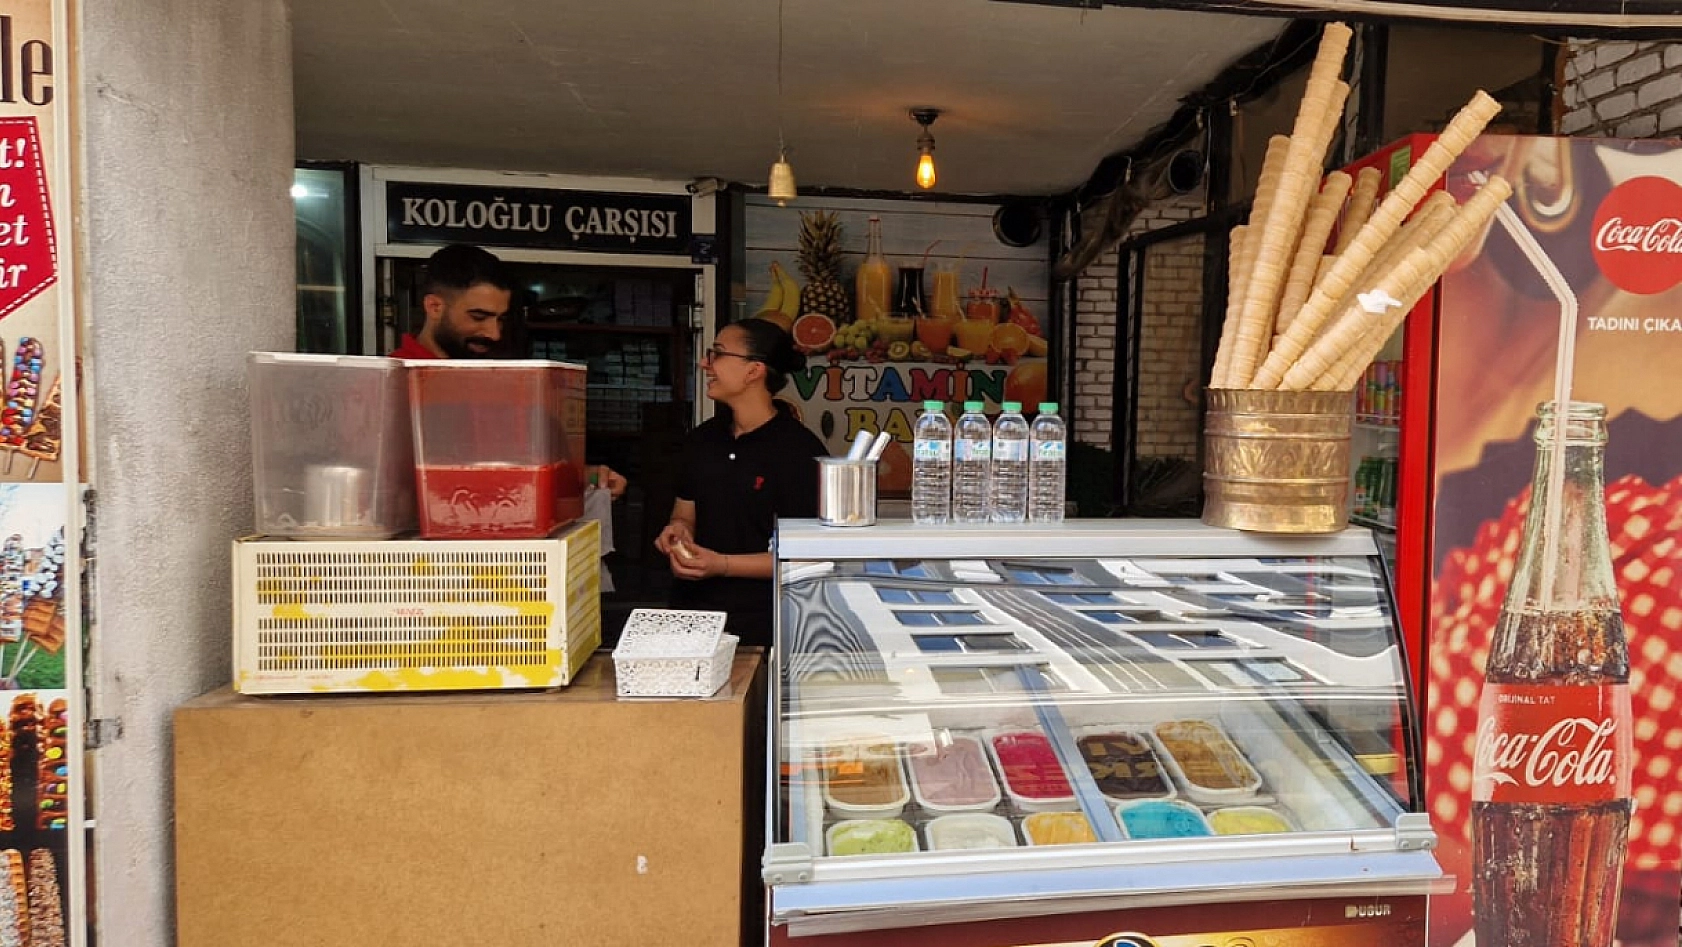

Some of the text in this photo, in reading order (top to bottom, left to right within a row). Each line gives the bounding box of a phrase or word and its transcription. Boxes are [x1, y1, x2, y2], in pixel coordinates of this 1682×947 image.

[402, 196, 678, 243] KOLOĞLU ÇARŞISI
[1587, 316, 1640, 331] TADINI
[845, 408, 924, 443] BA
[1539, 694, 1556, 705] TAT
